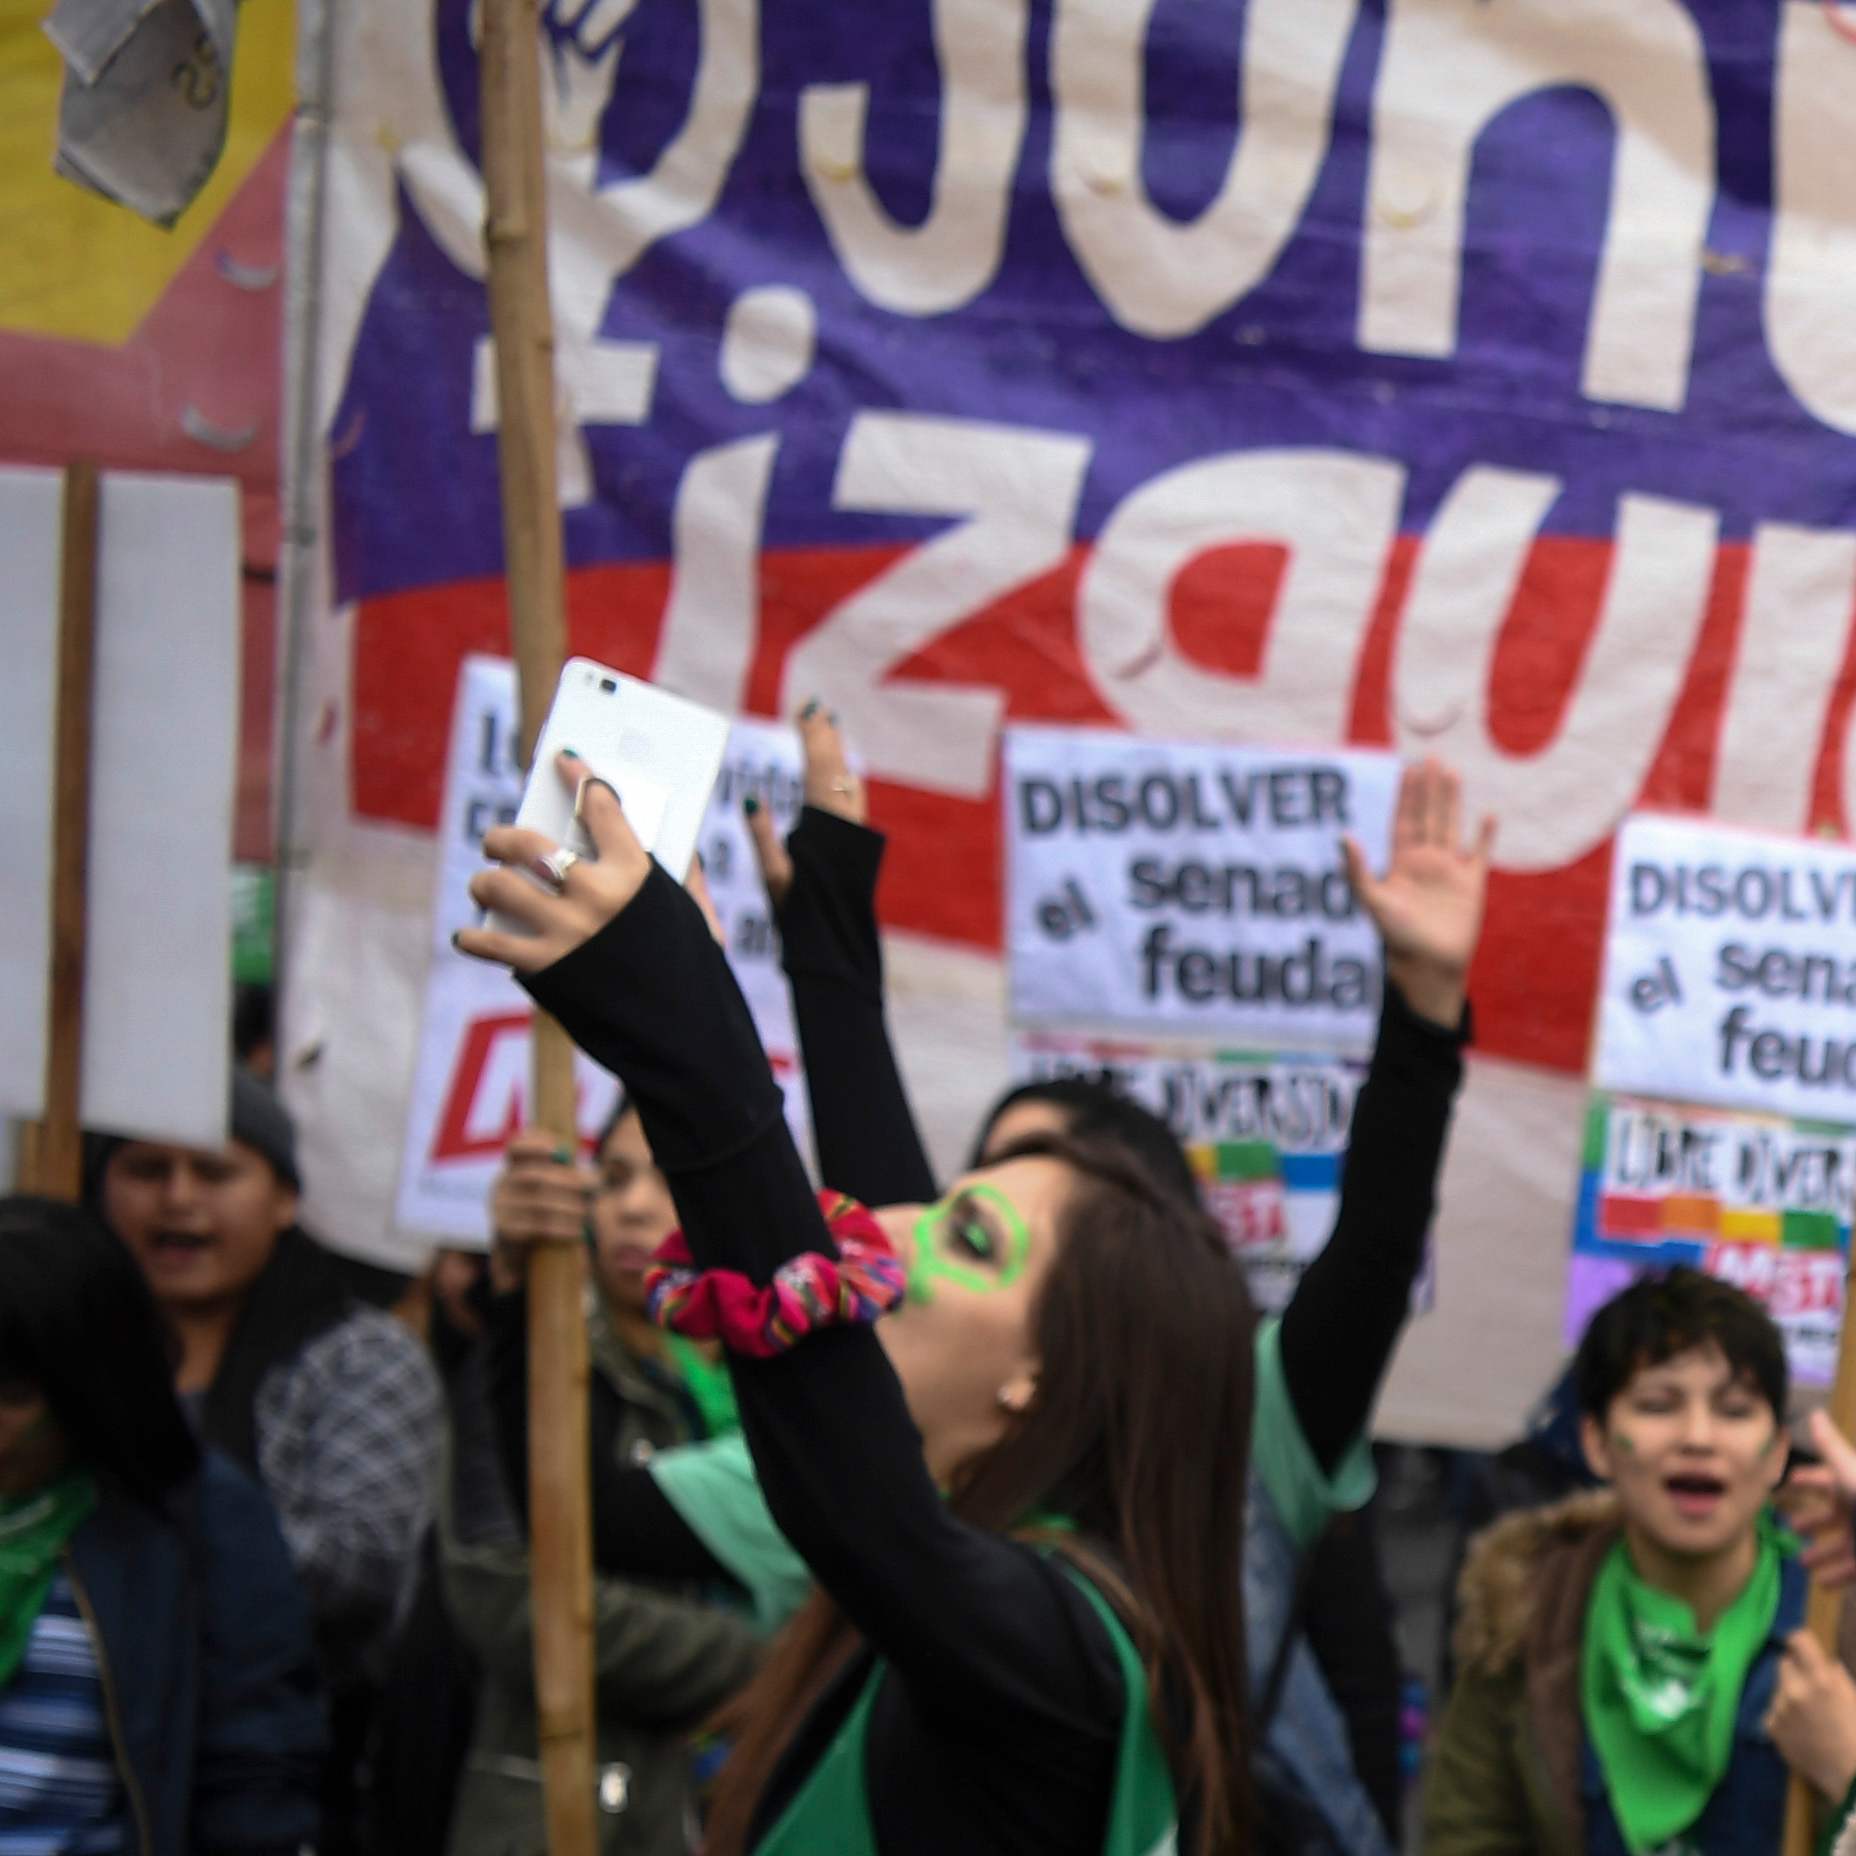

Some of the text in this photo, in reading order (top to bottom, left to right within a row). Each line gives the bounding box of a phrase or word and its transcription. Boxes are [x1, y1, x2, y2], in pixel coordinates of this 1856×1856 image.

[1017, 768, 1351, 840] DISOLVER
[1034, 872, 1097, 942] el
[1128, 852, 1356, 924] senad
[1138, 922, 1372, 1009] feuda
[1624, 953, 1683, 1016] el
